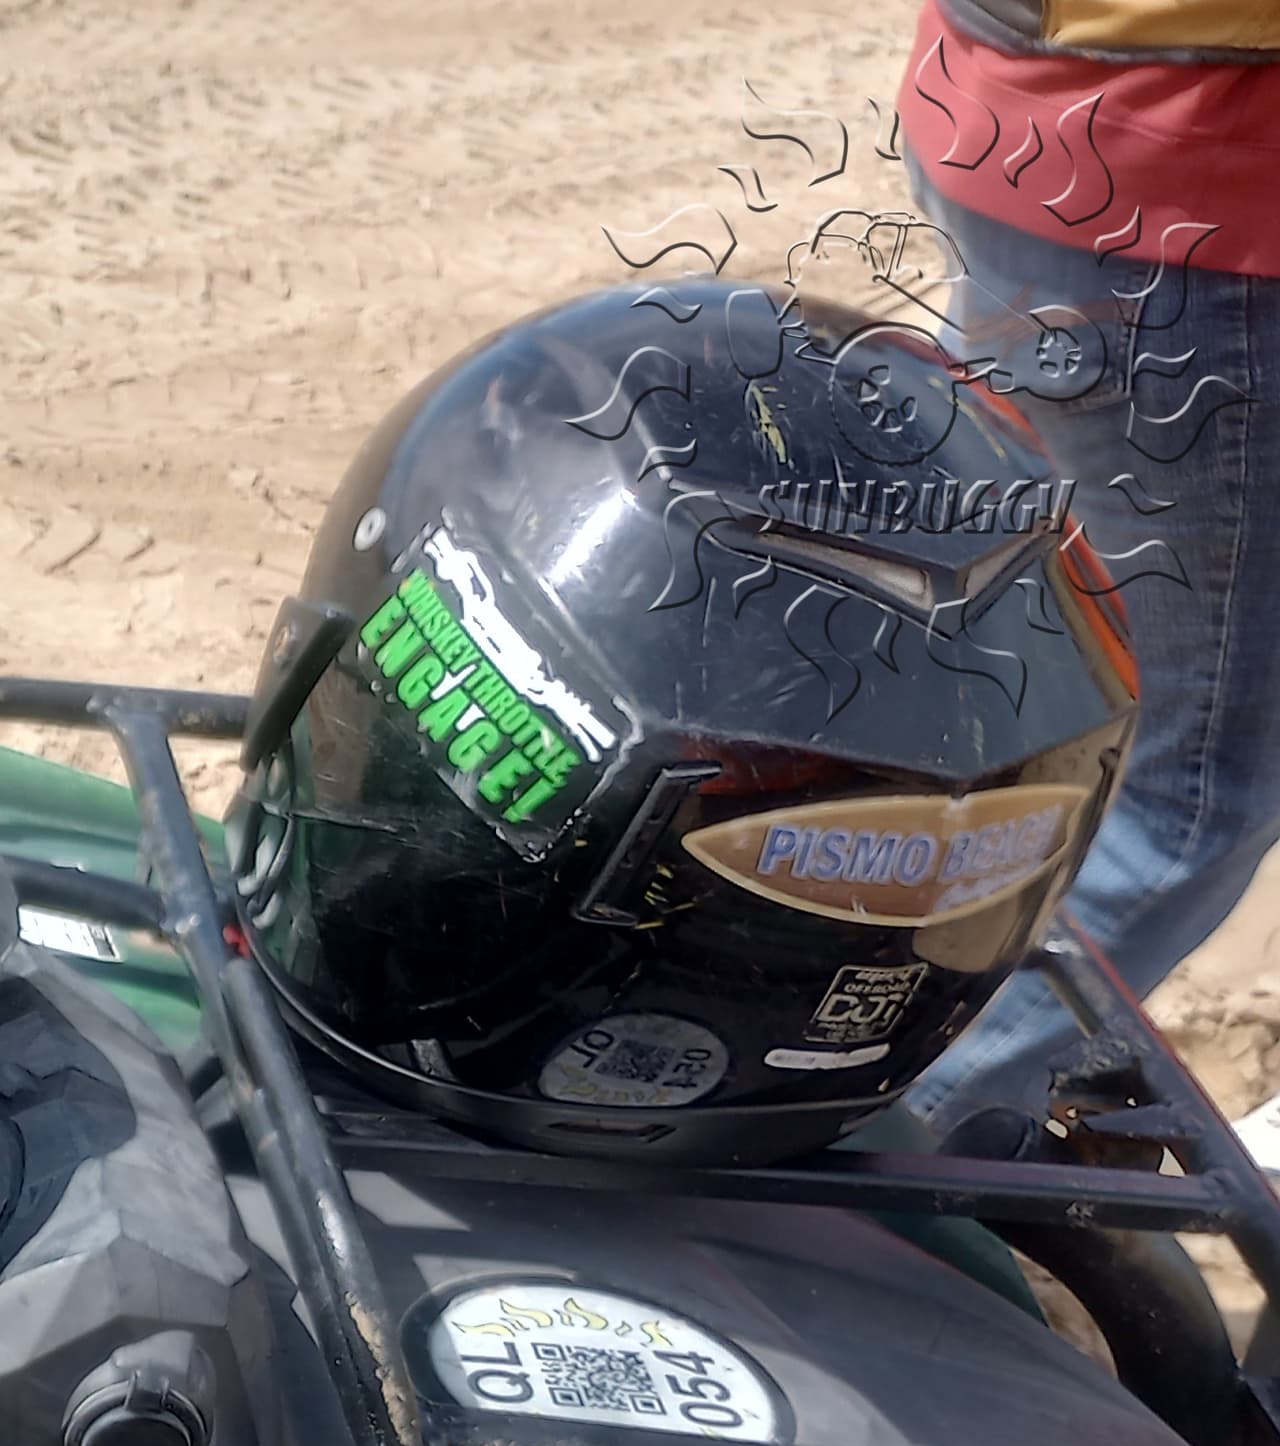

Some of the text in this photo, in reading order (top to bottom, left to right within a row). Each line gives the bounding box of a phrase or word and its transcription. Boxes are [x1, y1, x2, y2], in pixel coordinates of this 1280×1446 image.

[397, 567, 582, 788] WHISKEY THROTTLE
[757, 823, 938, 888] PISMO
[460, 1341, 534, 1404] QL
[653, 1349, 744, 1428] 054
